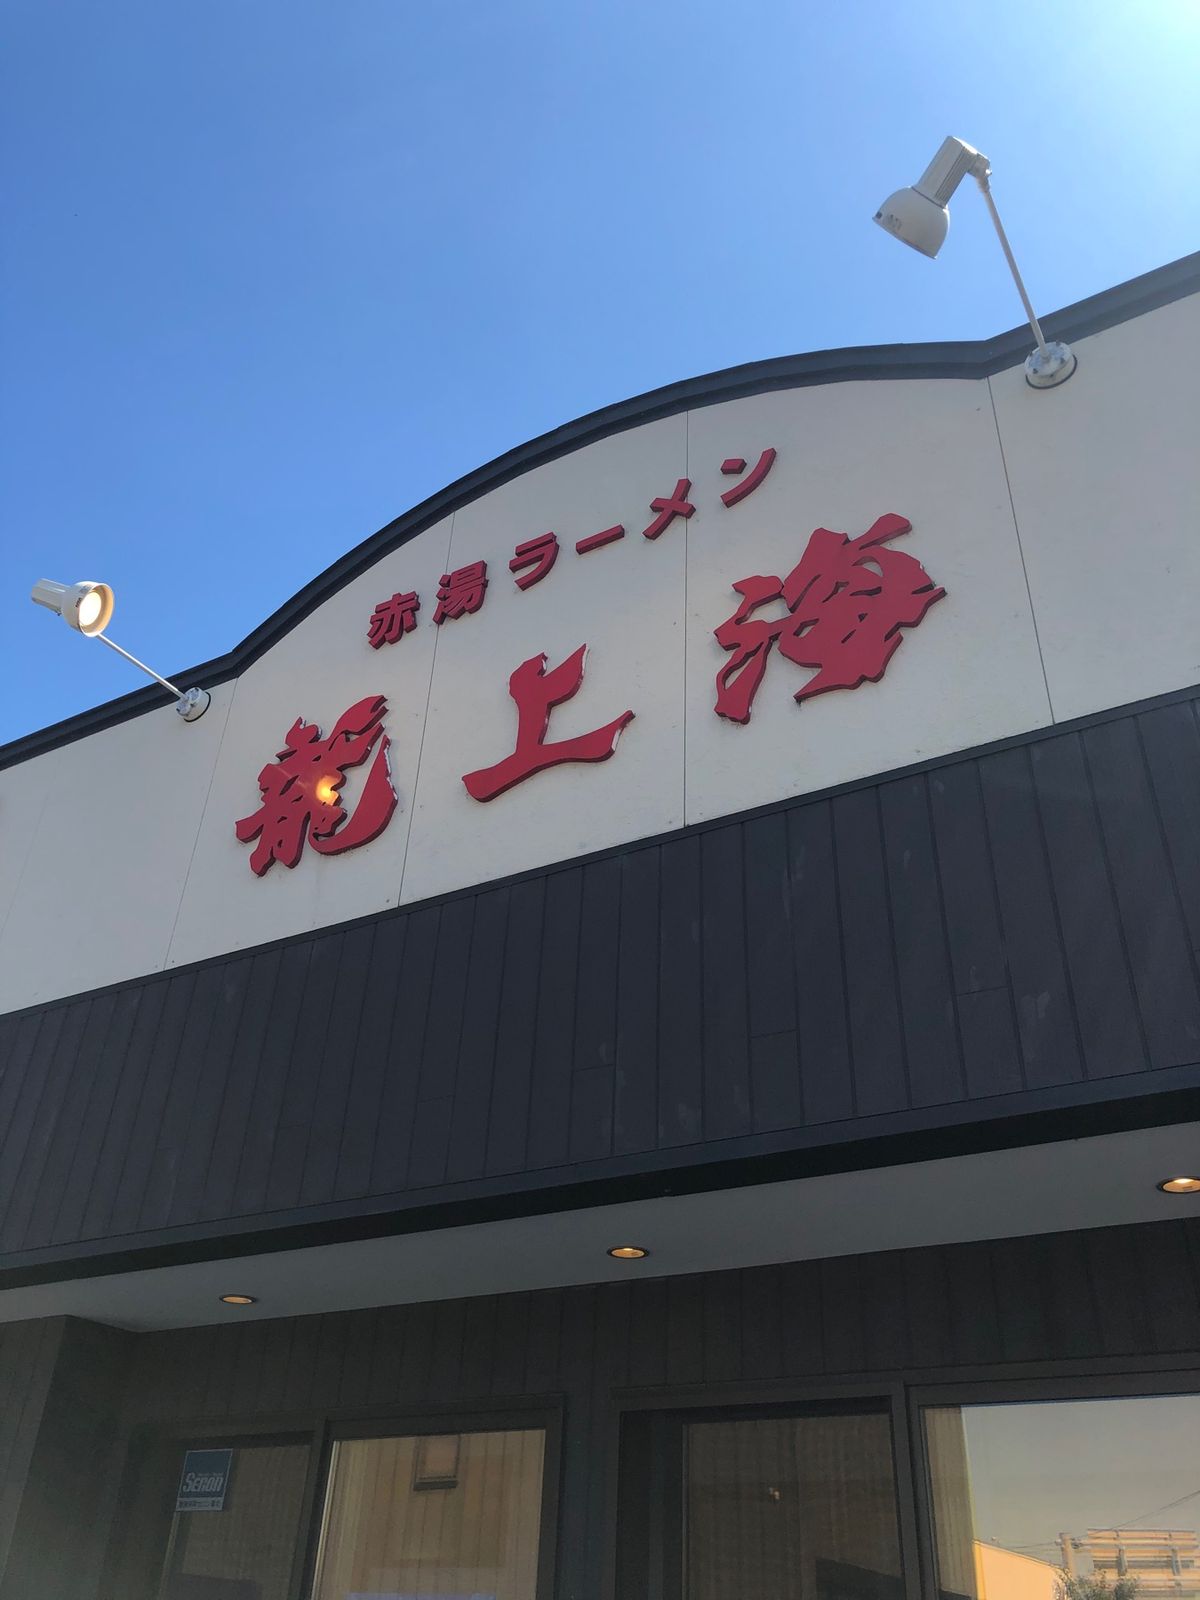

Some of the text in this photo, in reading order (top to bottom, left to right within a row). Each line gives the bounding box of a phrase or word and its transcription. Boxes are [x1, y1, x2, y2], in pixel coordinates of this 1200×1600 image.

[366, 448, 777, 650] 赤湯ラーメン
[236, 513, 947, 877] 龍上海
